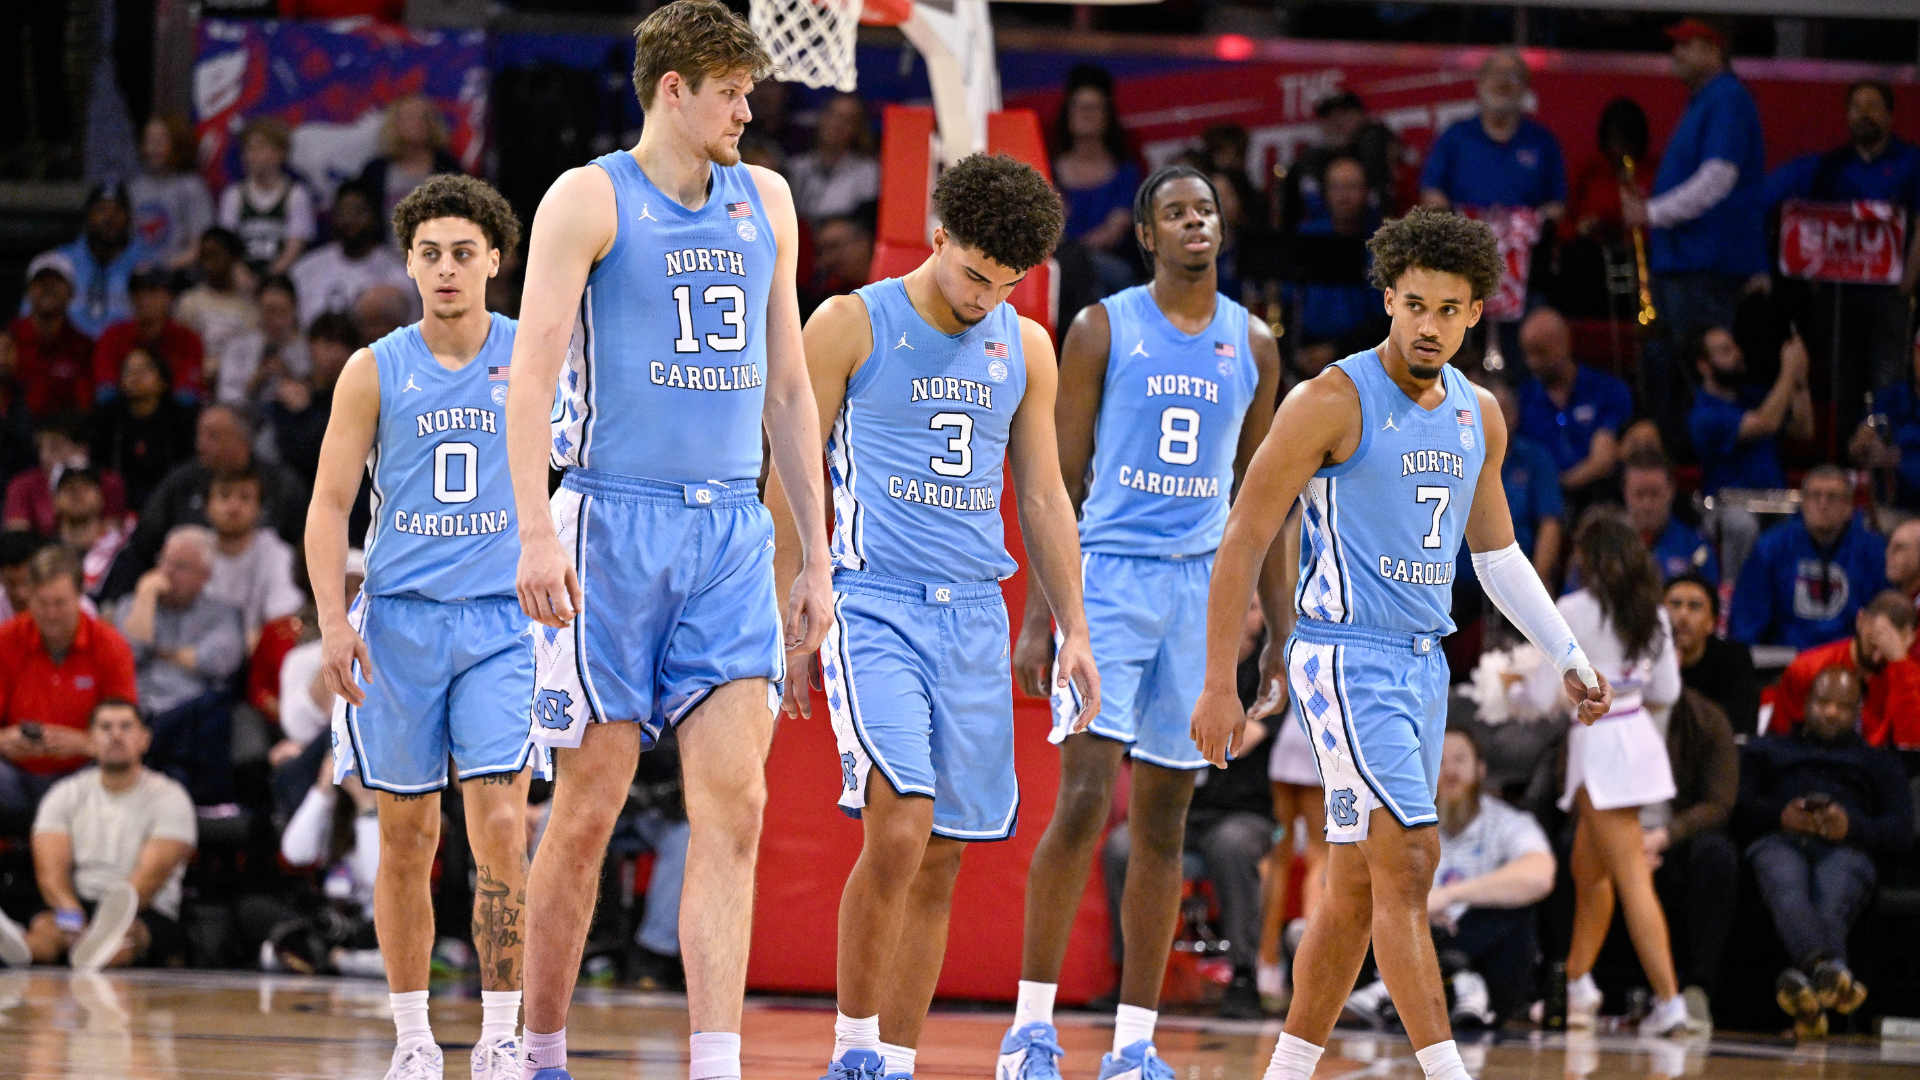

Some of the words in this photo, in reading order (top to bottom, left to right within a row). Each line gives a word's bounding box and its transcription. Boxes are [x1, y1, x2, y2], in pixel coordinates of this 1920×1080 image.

[665, 248, 746, 277] NORTH
[673, 284, 747, 353] 13
[649, 360, 762, 391] CAROLINA
[1146, 374, 1219, 404] NORTH
[911, 377, 992, 410] NORTH
[416, 407, 497, 438] NORTH
[1158, 406, 1200, 466] 8
[929, 412, 974, 478] 3
[433, 441, 478, 504] 0
[1118, 464, 1220, 498] CAROLINA
[1401, 450, 1464, 480] NORTH
[888, 475, 996, 511] CAROLINA
[394, 509, 508, 537] CAROLINA
[1415, 485, 1451, 549] 7
[1378, 555, 1453, 586] CAROLI
